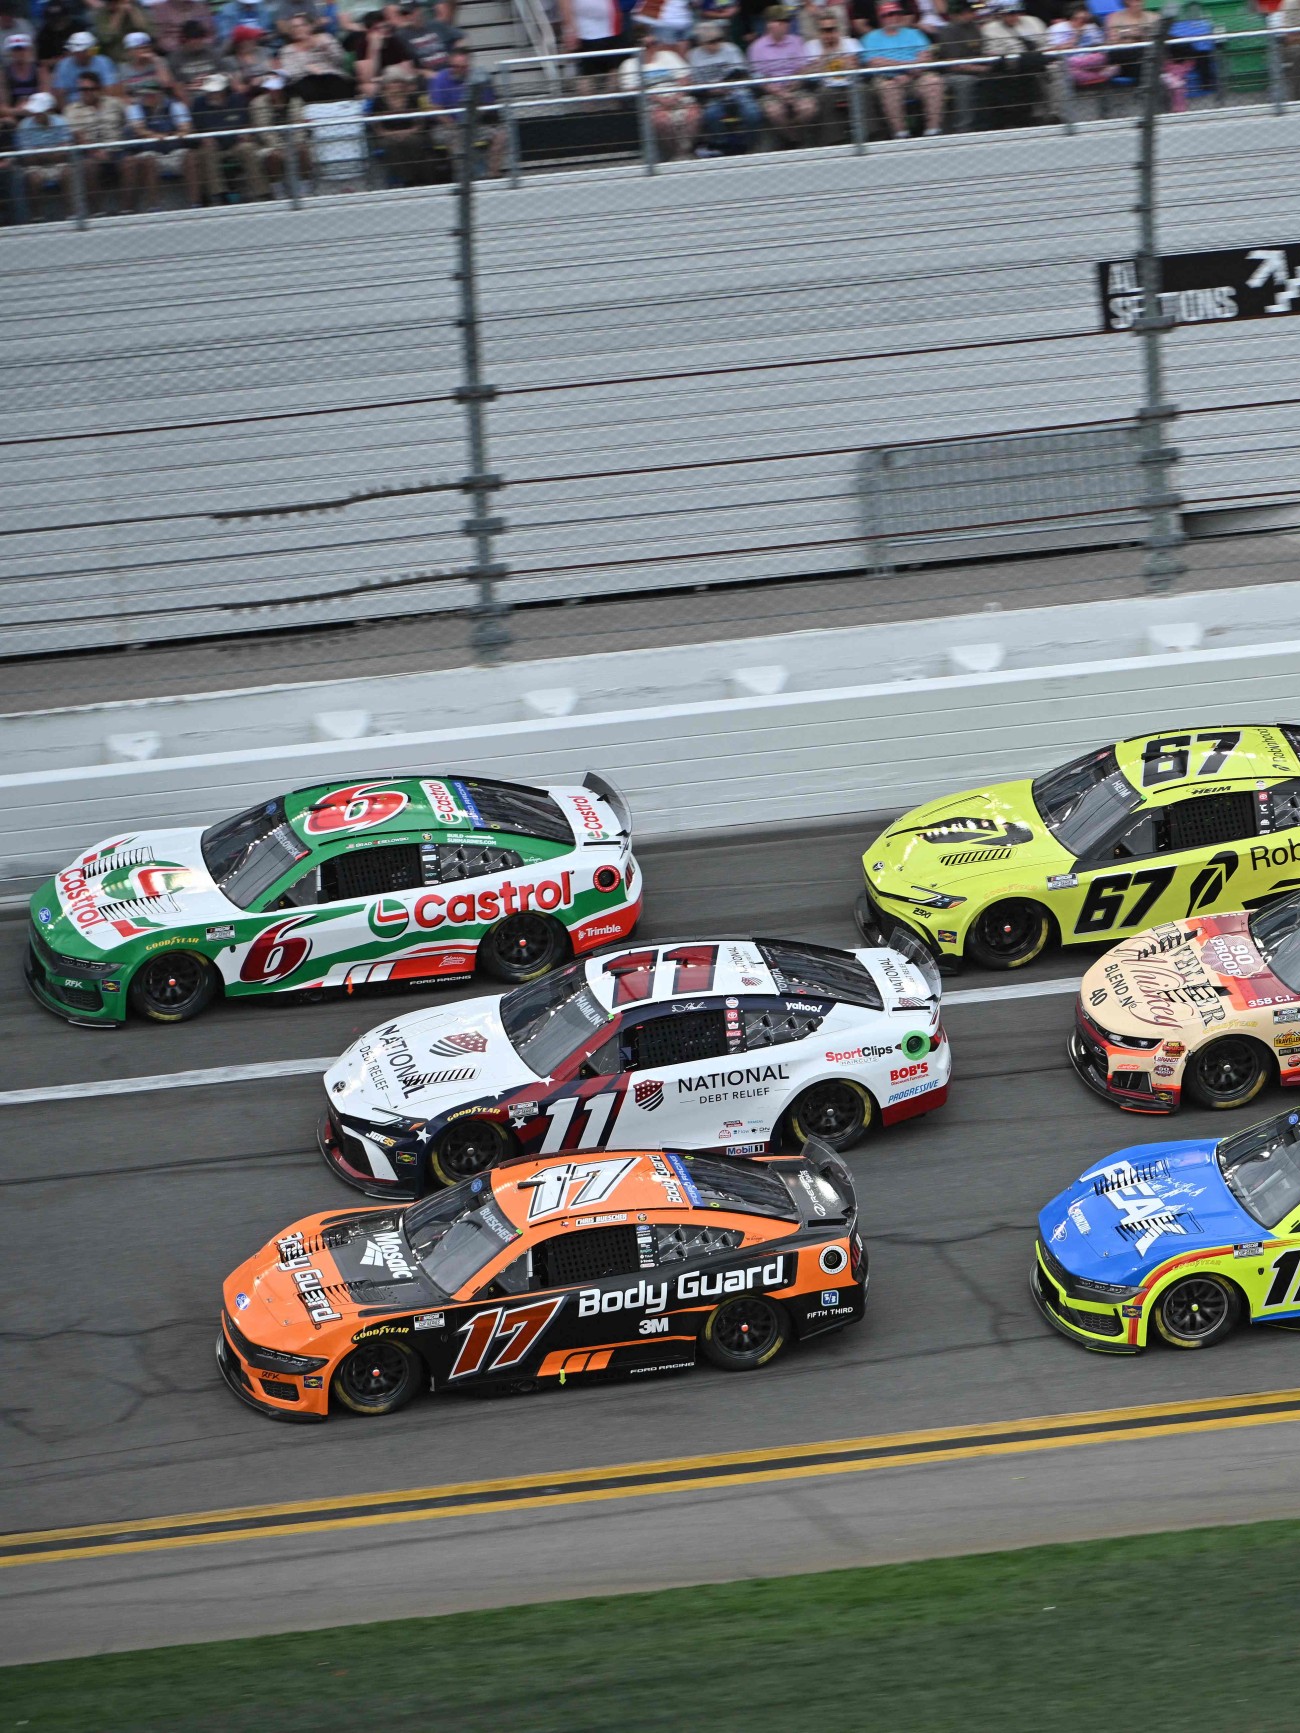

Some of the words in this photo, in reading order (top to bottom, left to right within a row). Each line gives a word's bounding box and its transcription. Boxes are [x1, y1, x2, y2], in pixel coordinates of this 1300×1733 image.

[1109, 285, 1240, 329] SETIONS
[1141, 731, 1242, 788] 67
[430, 782, 454, 814] Castrol
[1111, 780, 1129, 798] HEIM
[1192, 785, 1231, 795] HEIM
[304, 780, 412, 834] 6
[569, 795, 602, 831] Castrol
[58, 868, 108, 929] Castrol
[414, 871, 572, 929] Castrol
[1074, 865, 1178, 934] 67
[146, 937, 200, 951] GOODYEAR
[586, 924, 622, 937] Trimble
[240, 914, 319, 985] 6
[1210, 938, 1244, 976] PROOF
[1230, 944, 1256, 965] 90
[436, 974, 472, 983] RACING
[602, 945, 719, 1009] 11
[879, 957, 906, 993] NATIONAL
[1104, 963, 1129, 997] BLEND
[575, 995, 604, 1027] HAMLIN
[786, 1002, 823, 1013] yahoo!
[1089, 987, 1108, 1007] 40
[1247, 998, 1272, 1009] 358
[1274, 994, 1294, 1002] C.I.
[376, 1024, 426, 1100] NATIONAL
[825, 1045, 893, 1063] SportClips
[841, 1057, 878, 1066] HAIRCUTS
[367, 1064, 390, 1092] RELIEF
[678, 1065, 789, 1093] NATIONAL
[890, 1062, 929, 1081] BOB'S
[700, 1092, 727, 1104] DEBT
[732, 1087, 770, 1100] RELIEF
[888, 1079, 939, 1104] PROGRESSIVE
[447, 1105, 501, 1122] GOODYEAR
[539, 1091, 621, 1153] 11
[728, 1146, 753, 1156] Mobil
[755, 1144, 763, 1153] 1
[670, 1155, 690, 1181] RACING
[527, 1156, 643, 1222] 17
[480, 1208, 511, 1242] BUESCHER
[576, 1217, 595, 1226] CHRIS
[596, 1214, 627, 1223] BUESCHER
[373, 1232, 418, 1280] Mosaic
[578, 1280, 668, 1318] Body
[677, 1256, 784, 1299] Guard
[639, 1317, 669, 1334] 3M
[807, 1310, 828, 1319] FIFTH
[830, 1306, 854, 1316] THIRD
[353, 1325, 410, 1341] GOODYEAR
[448, 1296, 568, 1380] 17
[659, 1362, 695, 1371] RACING
